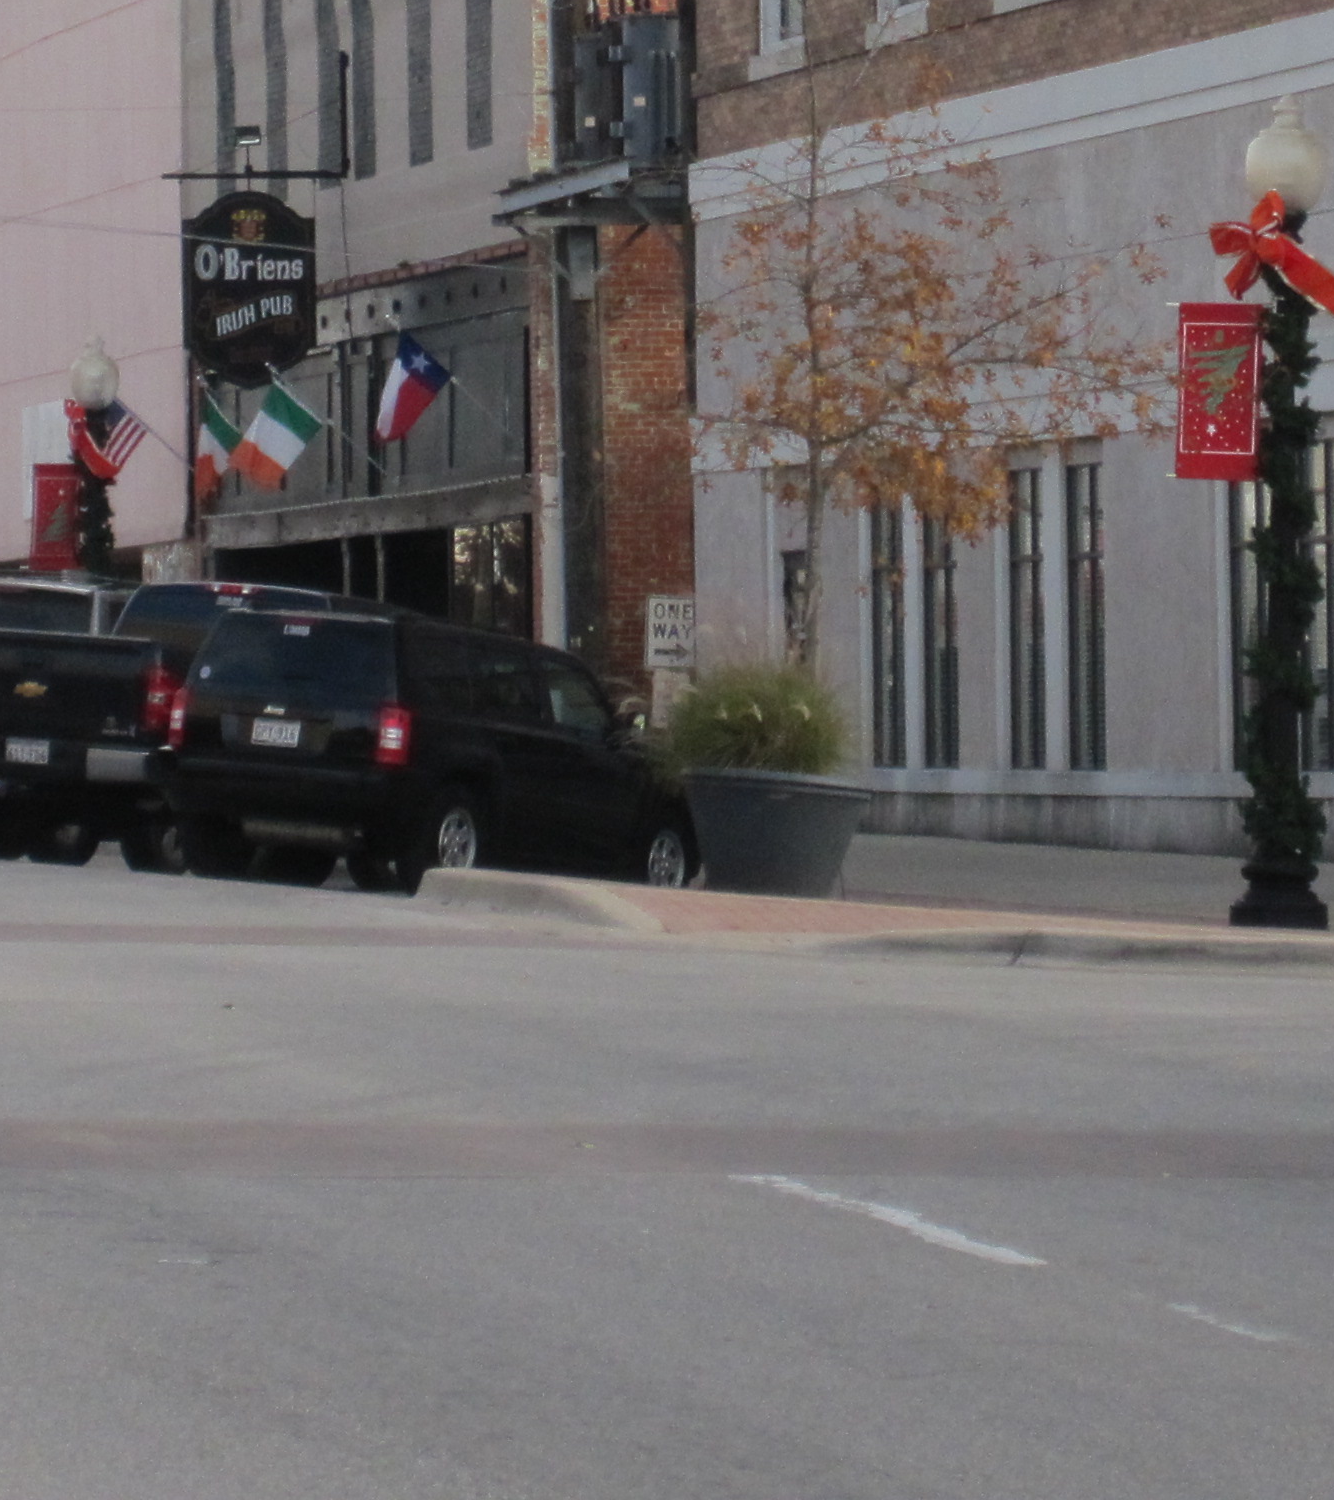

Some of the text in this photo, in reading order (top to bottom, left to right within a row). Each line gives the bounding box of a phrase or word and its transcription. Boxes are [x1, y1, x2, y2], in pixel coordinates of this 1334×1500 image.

[194, 243, 304, 281] O'Briens
[216, 294, 293, 337] IRISH PUB
[653, 602, 694, 620] ONE
[652, 622, 692, 640] WAY
